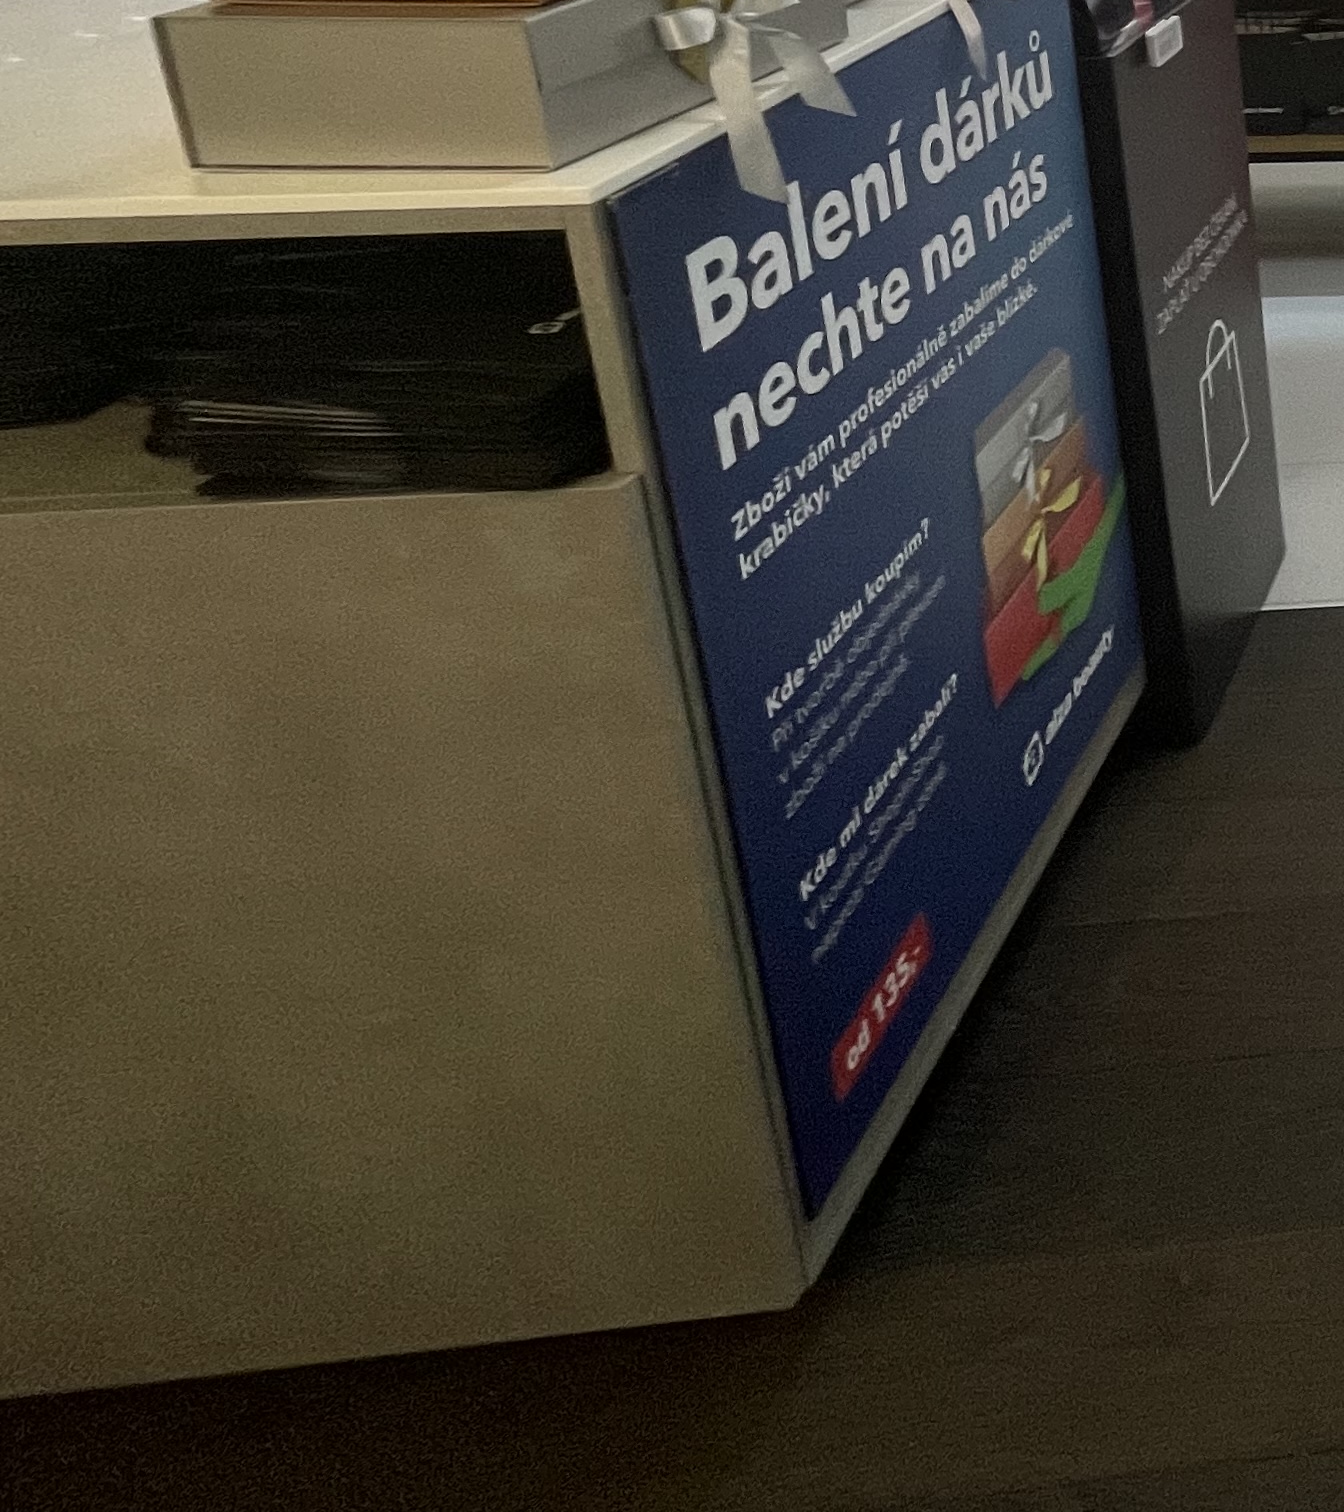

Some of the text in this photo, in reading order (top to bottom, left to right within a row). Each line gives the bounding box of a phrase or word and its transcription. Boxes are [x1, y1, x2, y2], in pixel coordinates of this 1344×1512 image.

[683, 29, 1054, 353] Balení dárků
[712, 150, 1049, 471] nechte na nás
[730, 210, 1075, 542] Zboží vám profesionálně zabalíme do dárkové
[738, 486, 831, 580] krabičky,
[831, 430, 879, 489] která
[880, 384, 930, 449] potěší
[956, 345, 966, 367] i
[964, 322, 997, 358] vaše
[765, 666, 806, 719] Kde
[807, 598, 863, 672] službu
[864, 516, 930, 604] koupím?
[799, 846, 837, 902] Kde
[863, 746, 909, 815] dárek
[846, 1018, 872, 1070] od
